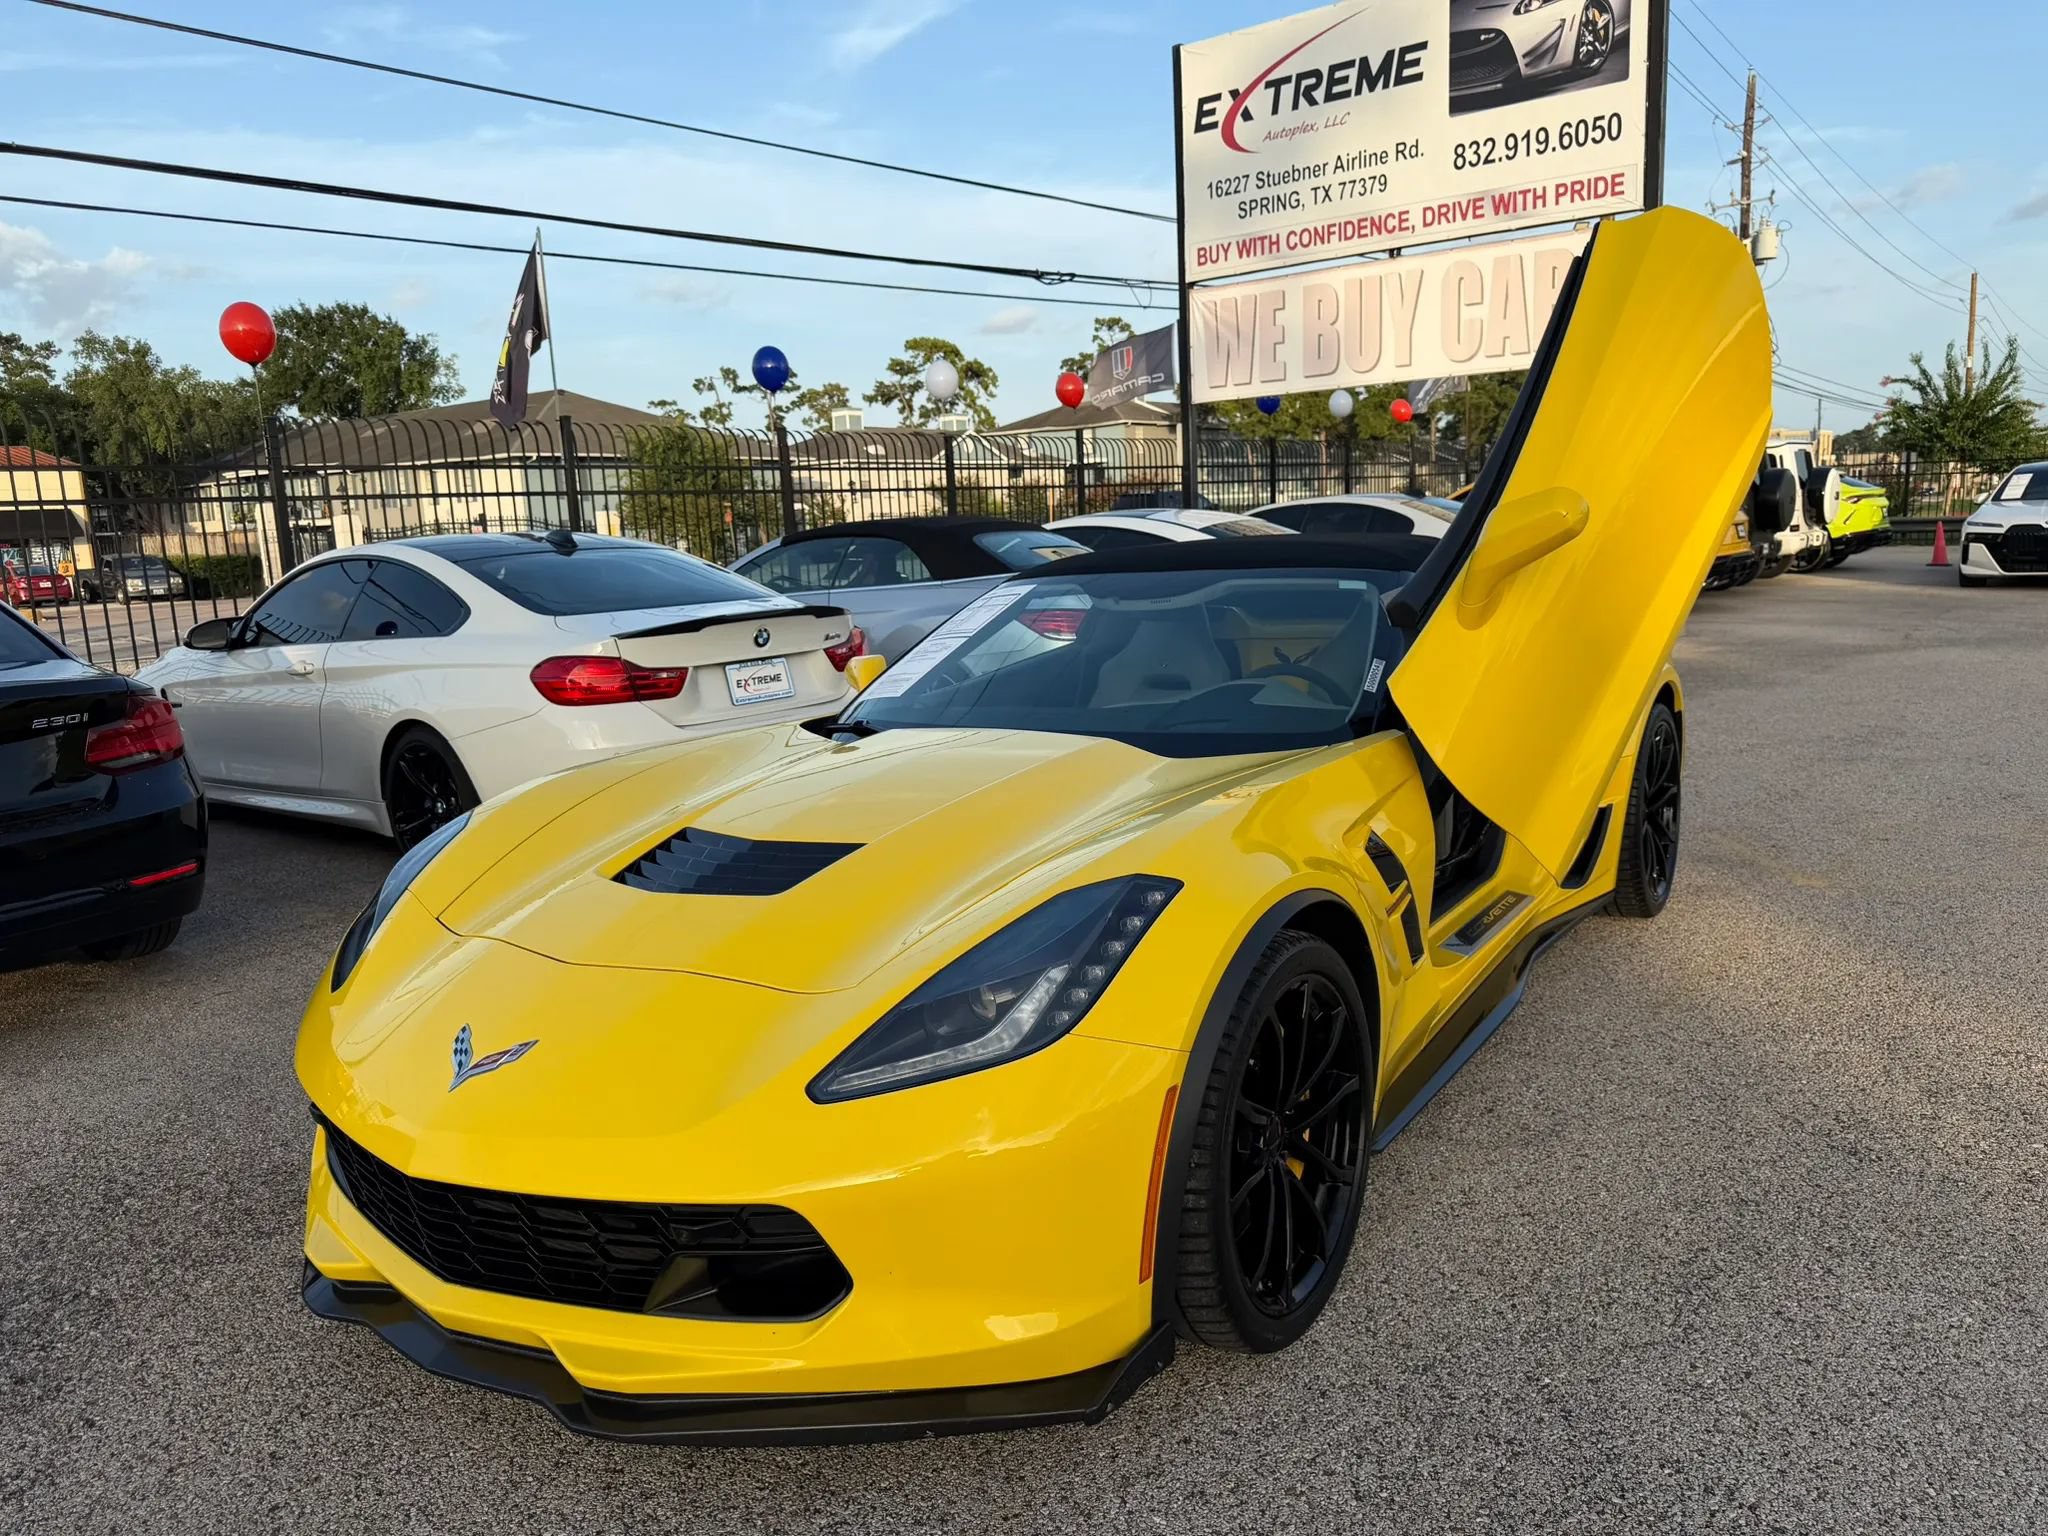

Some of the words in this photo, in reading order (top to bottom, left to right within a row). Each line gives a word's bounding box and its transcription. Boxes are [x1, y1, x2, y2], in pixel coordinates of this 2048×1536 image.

[1194, 40, 1429, 137] EXTREME
[1263, 119, 1319, 143] Autoplex,
[1324, 111, 1351, 128] LLC
[1453, 111, 1623, 171] 832.919.6050
[1206, 174, 1250, 200] 16227
[1255, 161, 1328, 190] Stuebner
[1333, 149, 1389, 175] Airline
[1395, 138, 1425, 162] Rd.
[1196, 241, 1232, 267] BUY
[1236, 232, 1281, 260] WITH
[1286, 209, 1416, 252] CONFIDENCE,
[1422, 196, 1486, 228] DRIVE
[1491, 185, 1547, 217] WITH
[1555, 172, 1625, 206] PRIDE
[1237, 190, 1306, 220] SPRING,
[1310, 183, 1333, 205] TX
[1338, 173, 1388, 201] 77379
[1203, 289, 1287, 389] WE
[1302, 267, 1424, 379] BUY
[736, 672, 783, 689] EXTREME
[32, 712, 89, 729] 230i
[1466, 893, 1518, 937] CORVETTE
